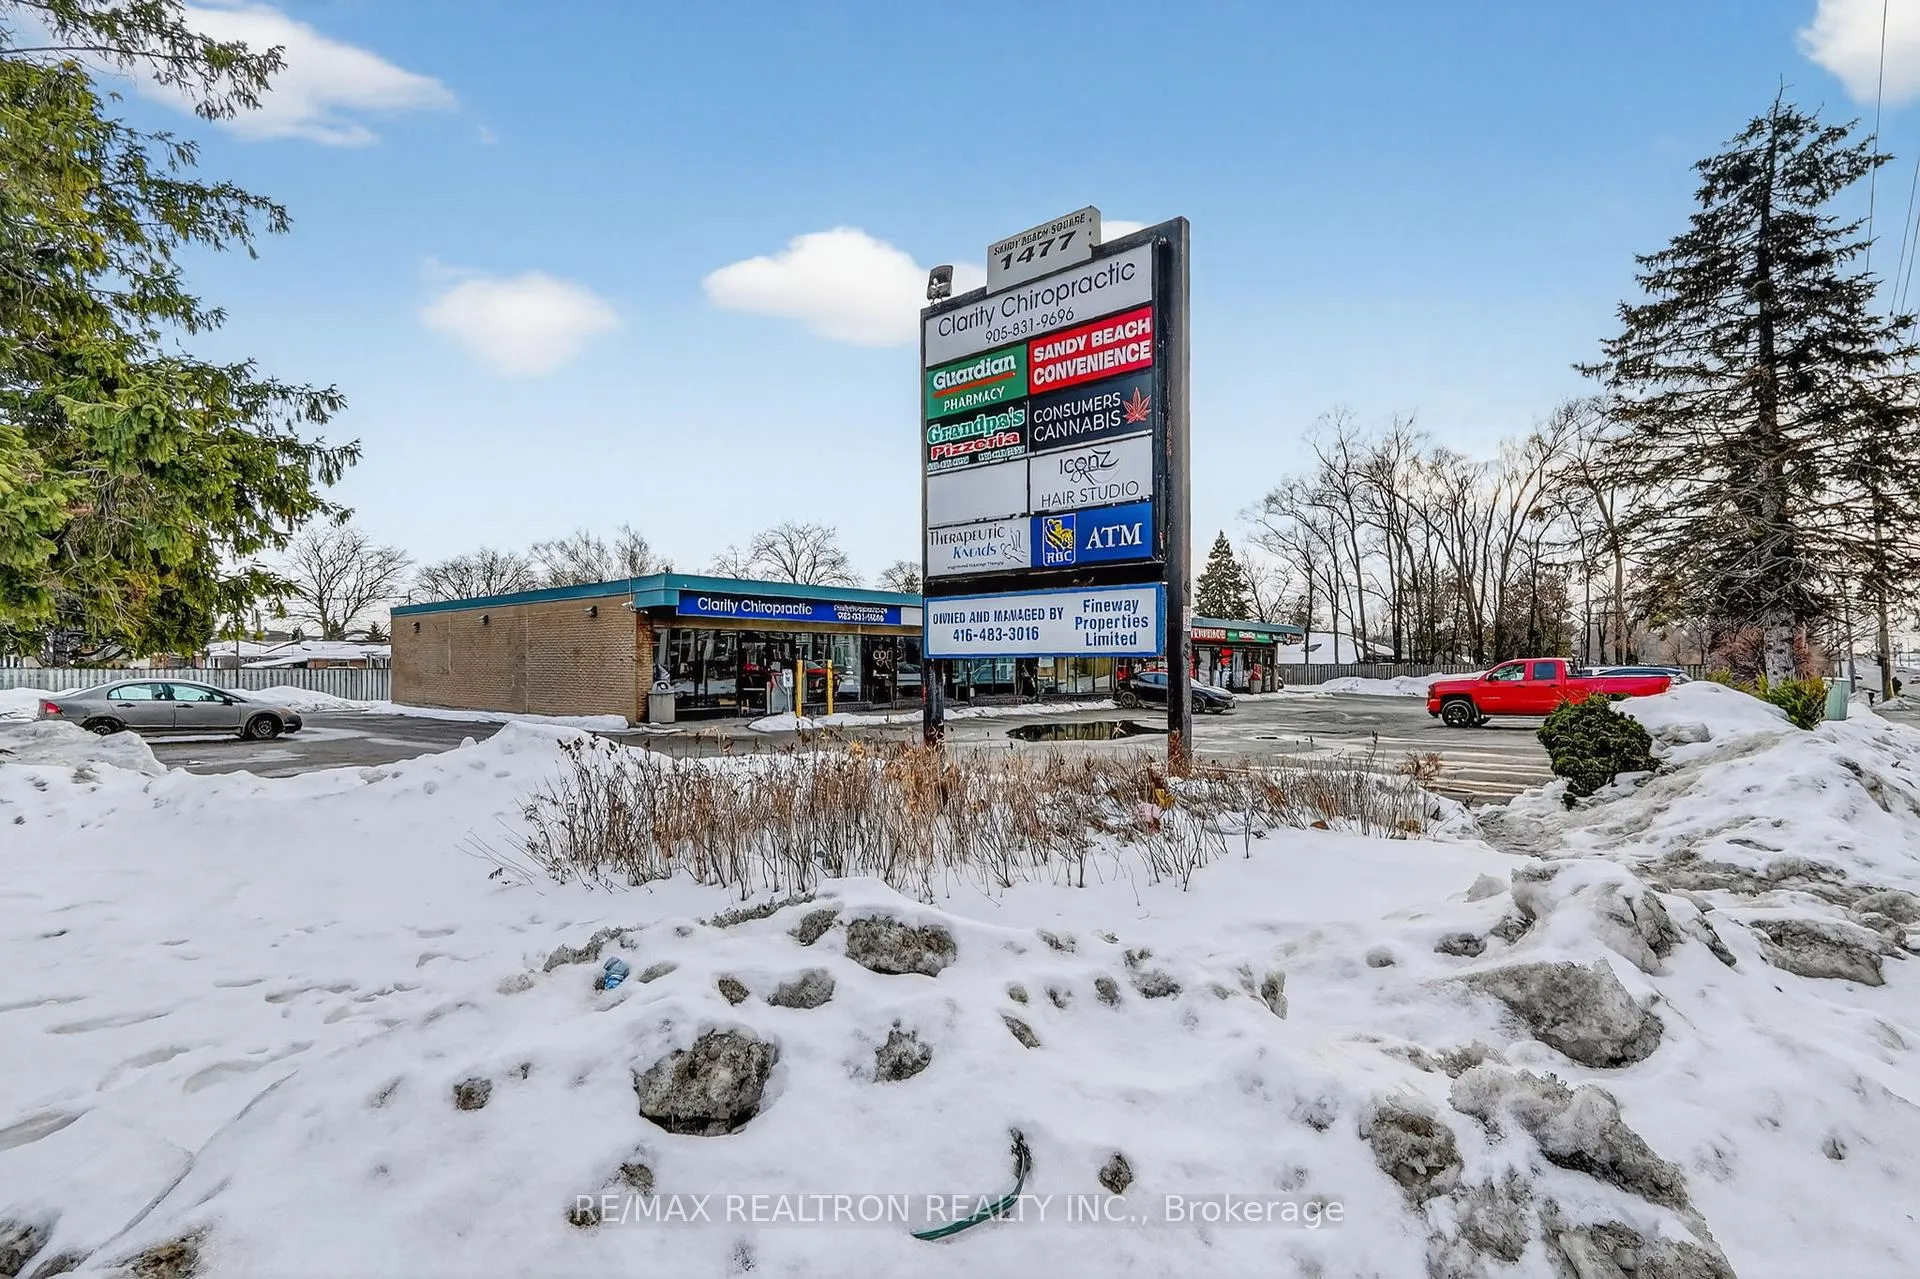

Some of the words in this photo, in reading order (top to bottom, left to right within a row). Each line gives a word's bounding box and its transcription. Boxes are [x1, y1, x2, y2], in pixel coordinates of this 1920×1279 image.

[1051, 213, 1086, 236] SQUARE
[1000, 230, 1077, 271] 1477
[938, 304, 996, 338] Clarity
[1001, 261, 1136, 319] Chiropractic
[985, 307, 1075, 344] 905-831-9696
[1033, 334, 1089, 363] SANDY
[1091, 316, 1151, 348] BEACH
[932, 353, 1017, 390] Guardian
[1033, 340, 1152, 386] CONVENIENCE
[943, 385, 1006, 412] PHARMACY
[1033, 391, 1121, 424] CONSUMERS
[927, 406, 1025, 445] Grandpa's
[1033, 410, 1122, 443] CANNABIS
[930, 431, 1020, 461] Pizzeria
[1041, 490, 1075, 508] HAIR
[1079, 480, 1139, 505] STUDIO
[1085, 522, 1143, 550] ATM
[1045, 551, 1073, 564] RBC
[697, 597, 738, 614] Clarity
[741, 599, 813, 616] Chiropractic
[932, 612, 965, 625] OWNED
[969, 611, 990, 624] AND
[994, 608, 1045, 623] MANAGED
[1049, 606, 1064, 621] BY
[1082, 598, 1139, 616] Fineway
[952, 626, 1039, 642] 416-483-3016
[1075, 614, 1149, 631] Properties
[1085, 630, 1137, 647] Limited
